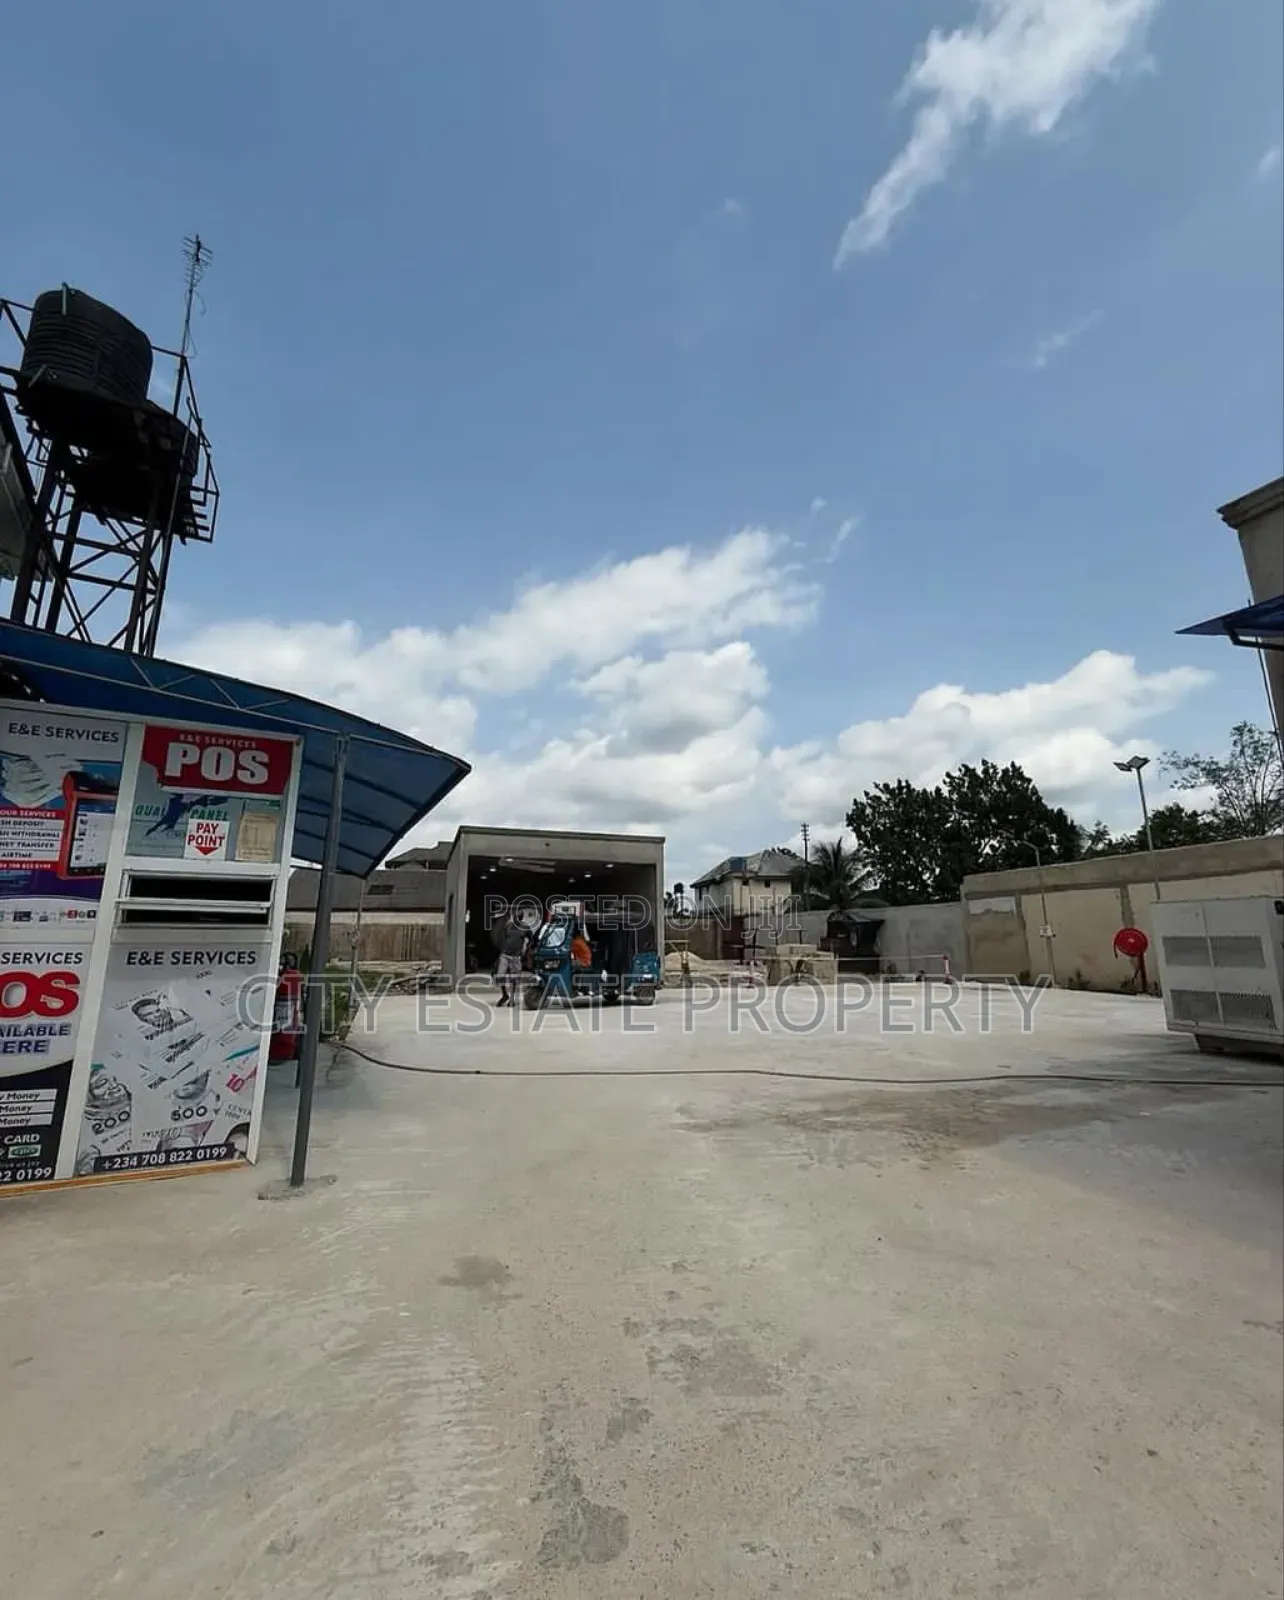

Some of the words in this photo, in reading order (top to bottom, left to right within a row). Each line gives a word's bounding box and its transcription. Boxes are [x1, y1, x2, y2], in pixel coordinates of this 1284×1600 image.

[9, 722, 41, 736] E&E
[45, 726, 120, 743] SERVICES
[204, 736, 257, 749] SERVICES
[164, 742, 270, 785] POS
[196, 823, 220, 834] PAY
[188, 834, 225, 847] POINT
[1, 952, 83, 965] SERVICES
[126, 951, 165, 966] E&E
[169, 950, 256, 966] SERVICES
[0, 1039, 50, 1055] ERE
[7, 1092, 40, 1101] Money
[171, 1105, 208, 1122] 500
[4, 1133, 40, 1145] CARD
[102, 1156, 138, 1170] +234
[141, 1152, 167, 1166] 708
[170, 1150, 193, 1163] 822
[196, 1147, 228, 1160] 0199
[16, 1166, 52, 1181] 0199
